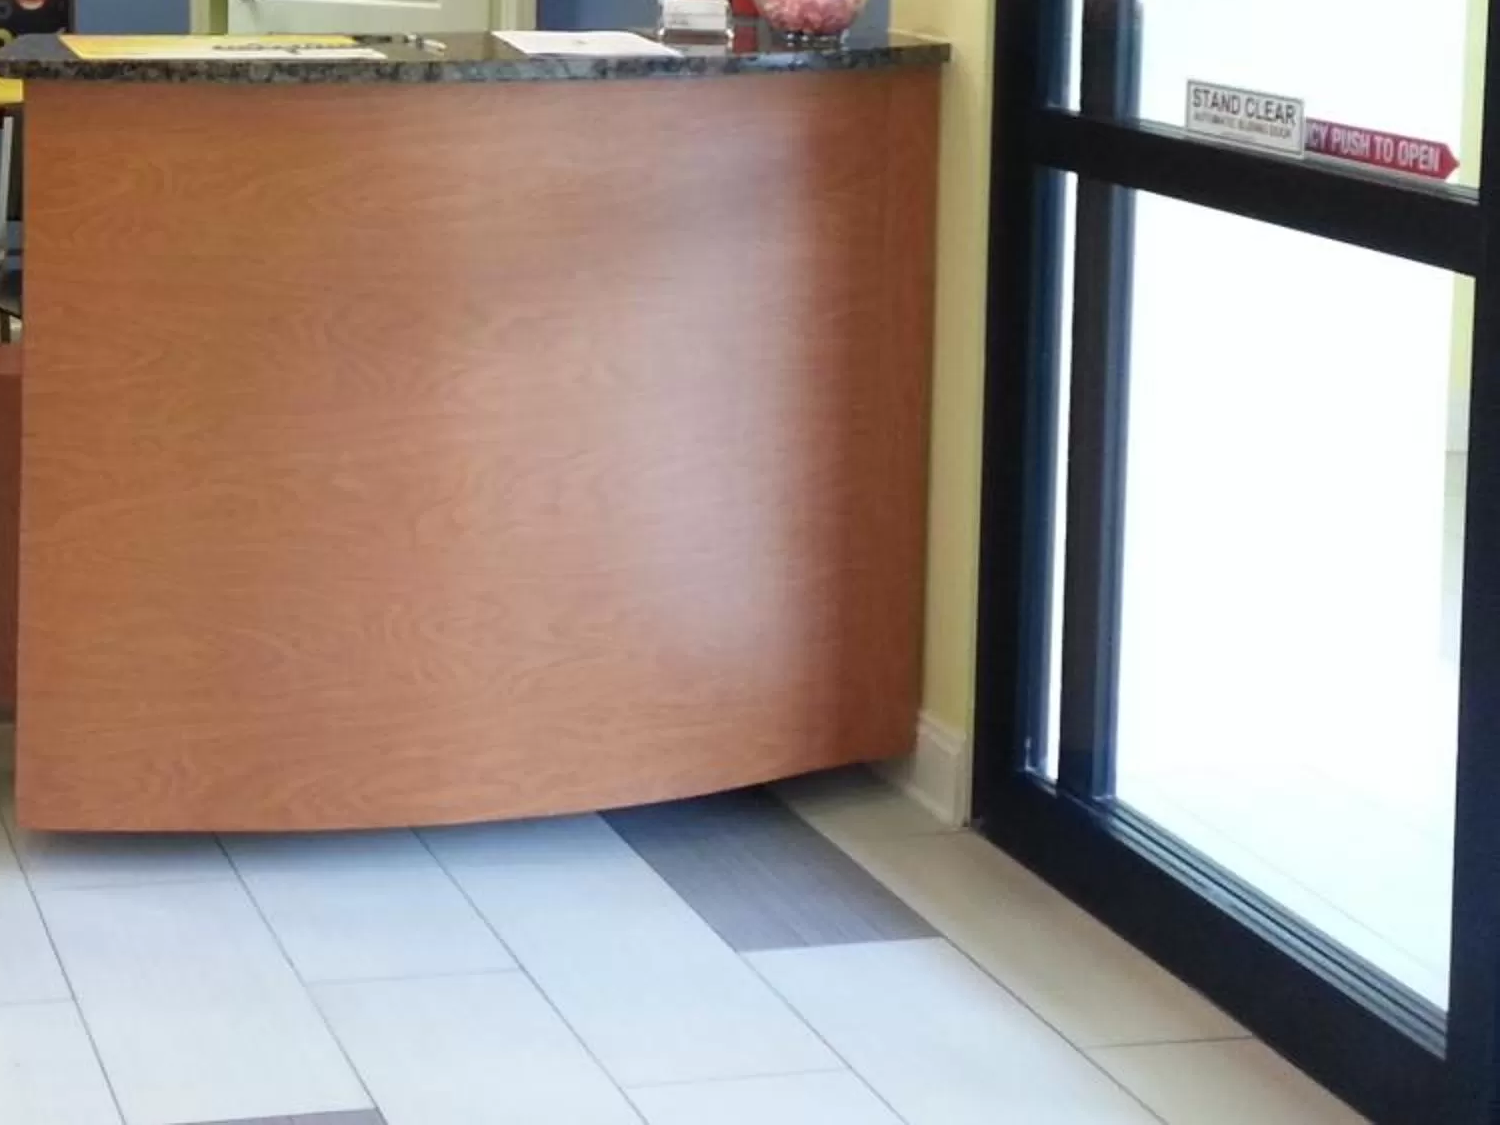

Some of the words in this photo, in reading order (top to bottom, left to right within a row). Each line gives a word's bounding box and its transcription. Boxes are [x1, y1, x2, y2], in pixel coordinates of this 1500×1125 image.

[1192, 87, 1241, 116] STAND
[1245, 96, 1297, 127] CLEAR
[1306, 122, 1329, 151] CY
[1330, 126, 1371, 158] PUSH
[1373, 135, 1394, 164] TO
[1397, 139, 1442, 173] OPEN
